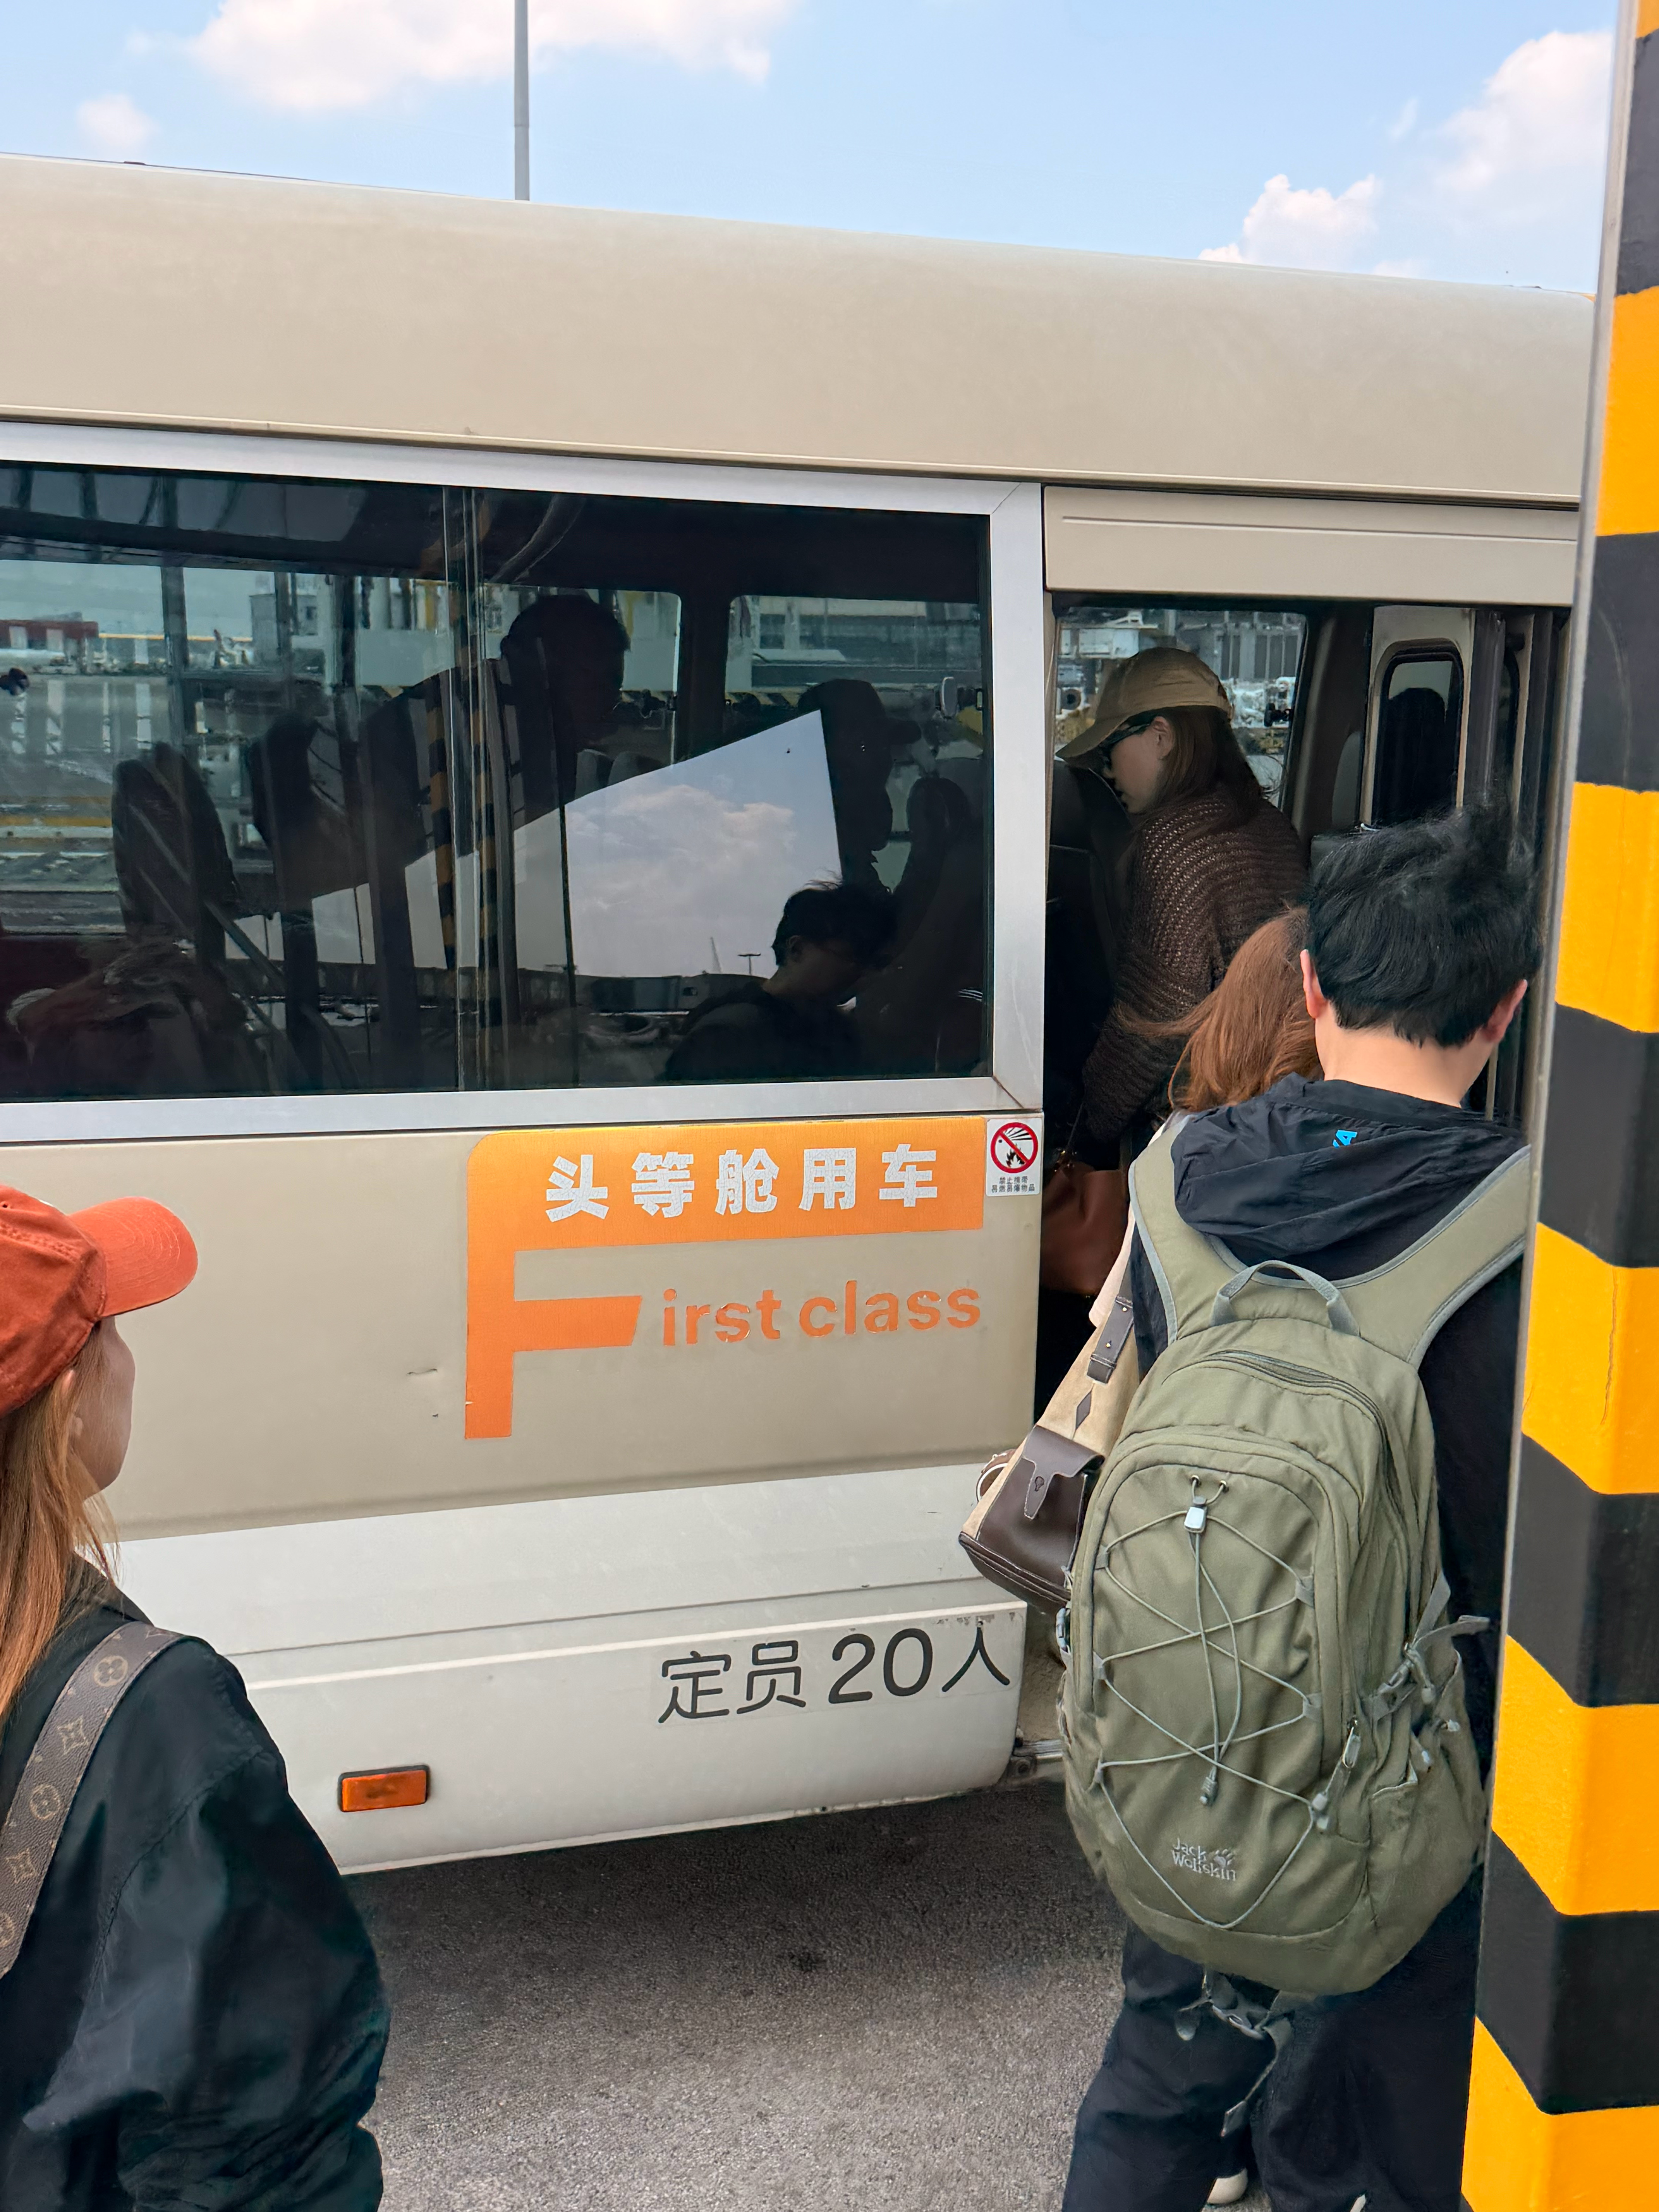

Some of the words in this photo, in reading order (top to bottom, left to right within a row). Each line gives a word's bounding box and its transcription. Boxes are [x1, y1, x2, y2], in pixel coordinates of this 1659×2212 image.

[545, 1143, 938, 1223] 头等舱用车
[799, 1280, 981, 1338] class
[658, 1622, 1010, 1723] 定员20人
[1171, 1849, 1236, 1882] Wolfskin
[1173, 1838, 1207, 1862] Jack
